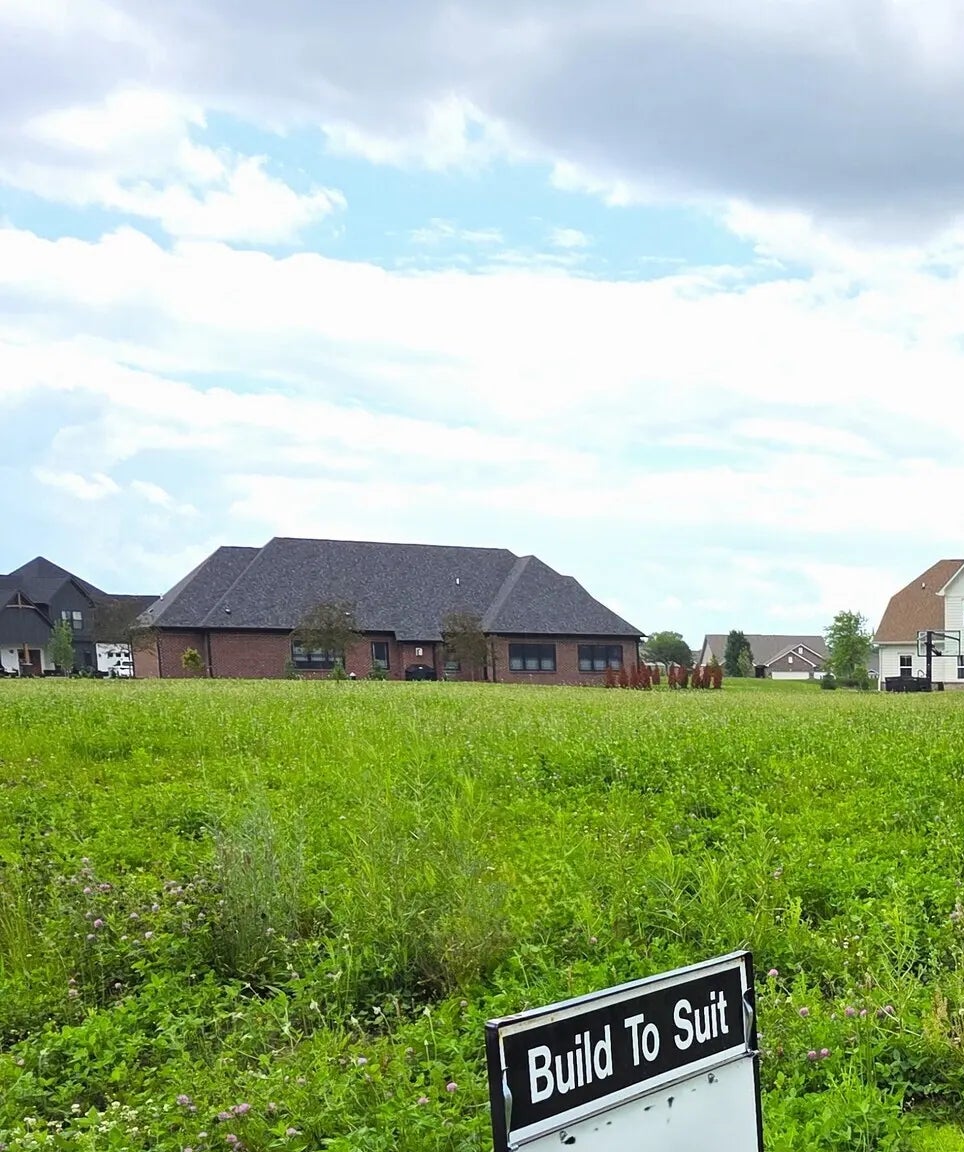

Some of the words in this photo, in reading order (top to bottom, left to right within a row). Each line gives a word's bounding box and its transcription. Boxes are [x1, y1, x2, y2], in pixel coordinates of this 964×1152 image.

[528, 1024, 613, 1103] Build
[624, 1013, 660, 1066] To
[673, 990, 729, 1051] Suit
